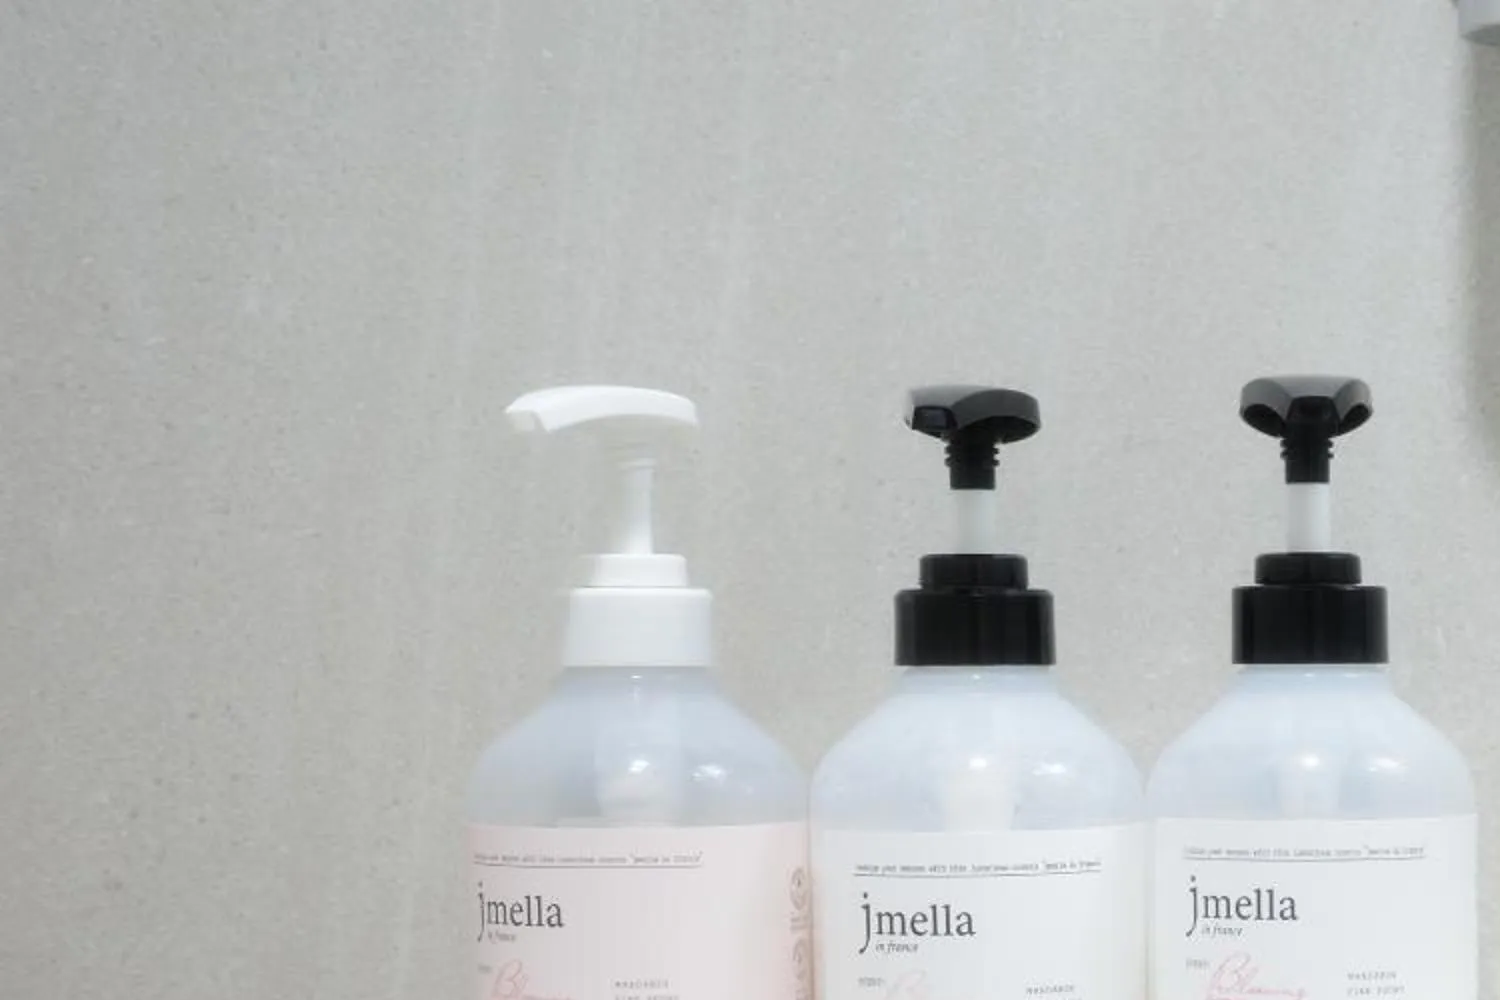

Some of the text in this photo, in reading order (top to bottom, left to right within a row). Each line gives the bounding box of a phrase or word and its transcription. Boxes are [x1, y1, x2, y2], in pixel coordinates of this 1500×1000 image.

[476, 880, 564, 943] jmella
[858, 891, 977, 955] jmella
[1185, 874, 1299, 938] jmella
